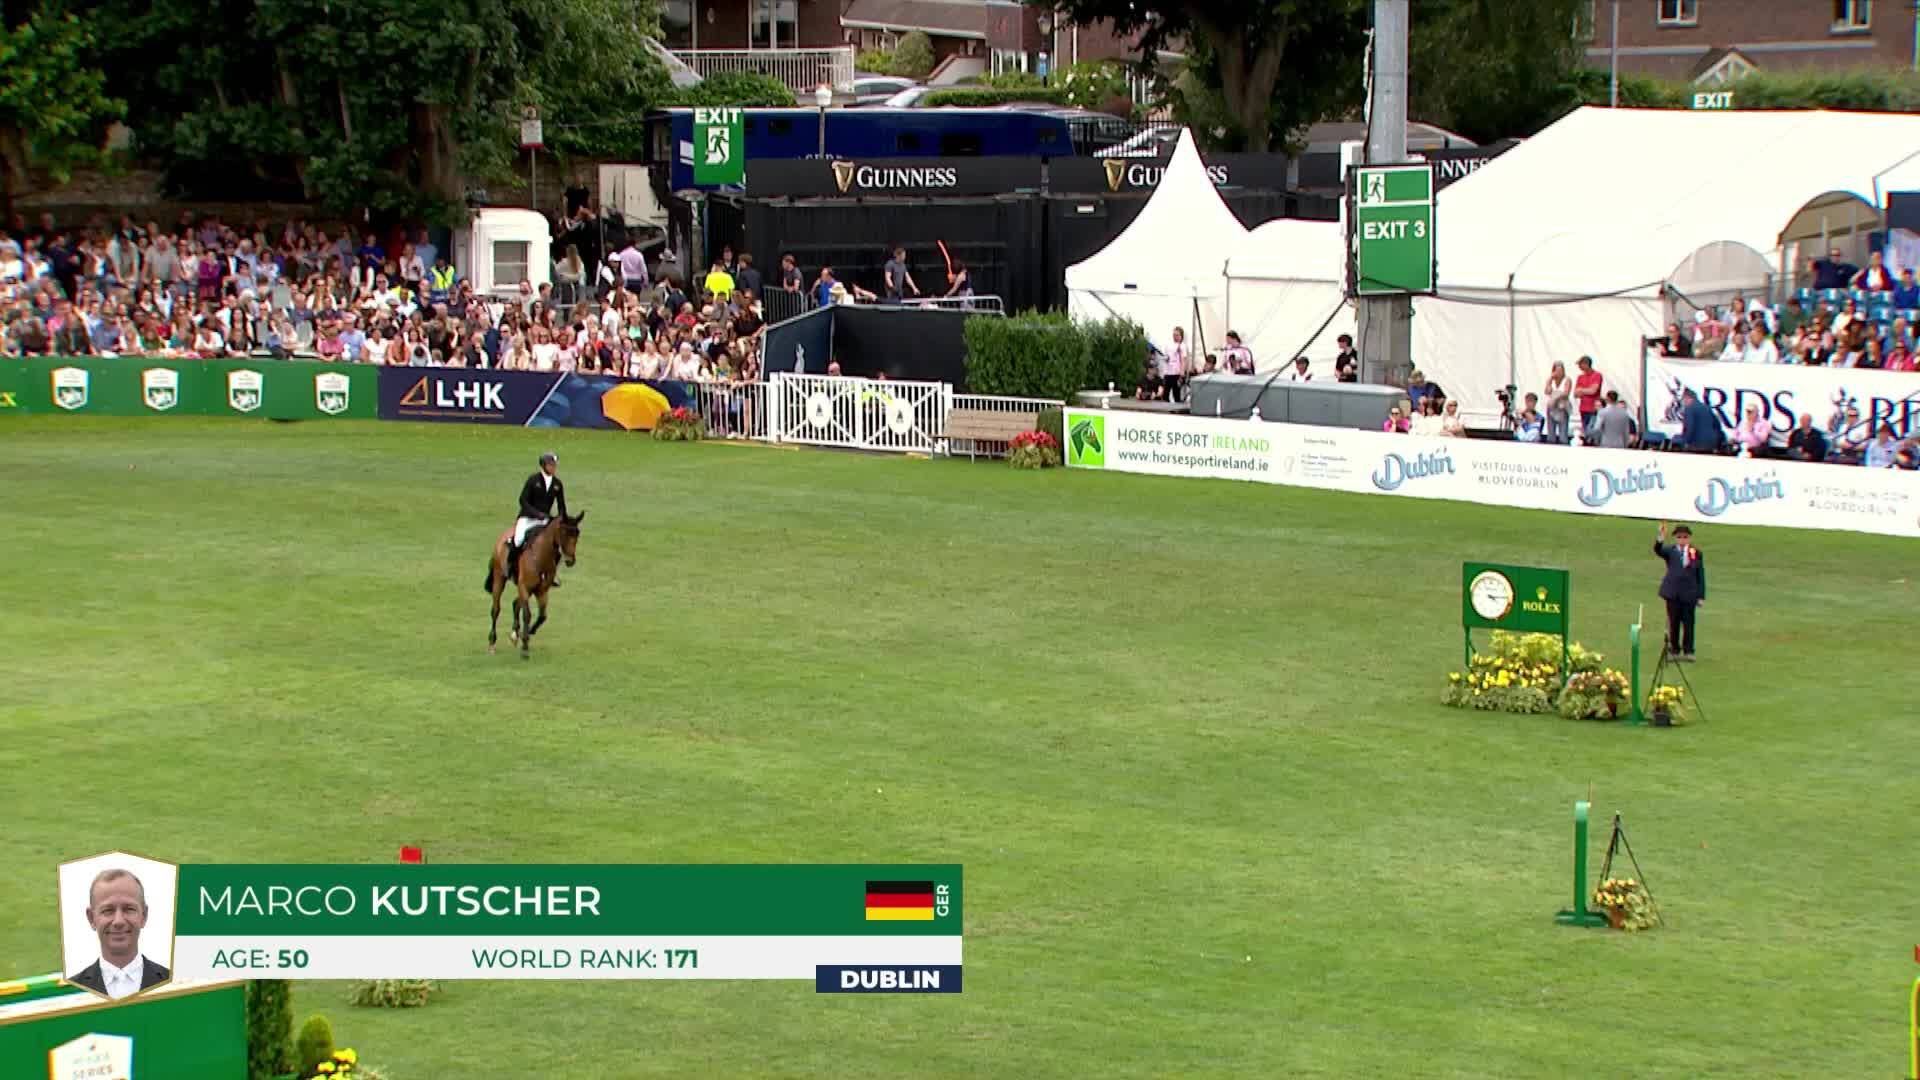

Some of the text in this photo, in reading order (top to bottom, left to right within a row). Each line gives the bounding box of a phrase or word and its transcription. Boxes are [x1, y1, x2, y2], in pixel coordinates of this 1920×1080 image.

[1694, 92, 1733, 109] EXIT
[695, 108, 741, 123] EXIT
[856, 166, 957, 187] GUINNESS
[1363, 219, 1426, 240] EXIT 3
[435, 379, 505, 409] LHK
[1702, 386, 1797, 432] RDS
[1117, 428, 1269, 453] HORSE SPORT IRELAND
[1118, 449, 1269, 472] www.horsesportireland.ie
[1372, 446, 1456, 491] Dublin
[1478, 476, 1559, 490] #LOVEDUBLIN
[1577, 460, 1666, 507] Dublin
[1695, 469, 1784, 516] Dublin
[1523, 601, 1560, 613] ROLEX
